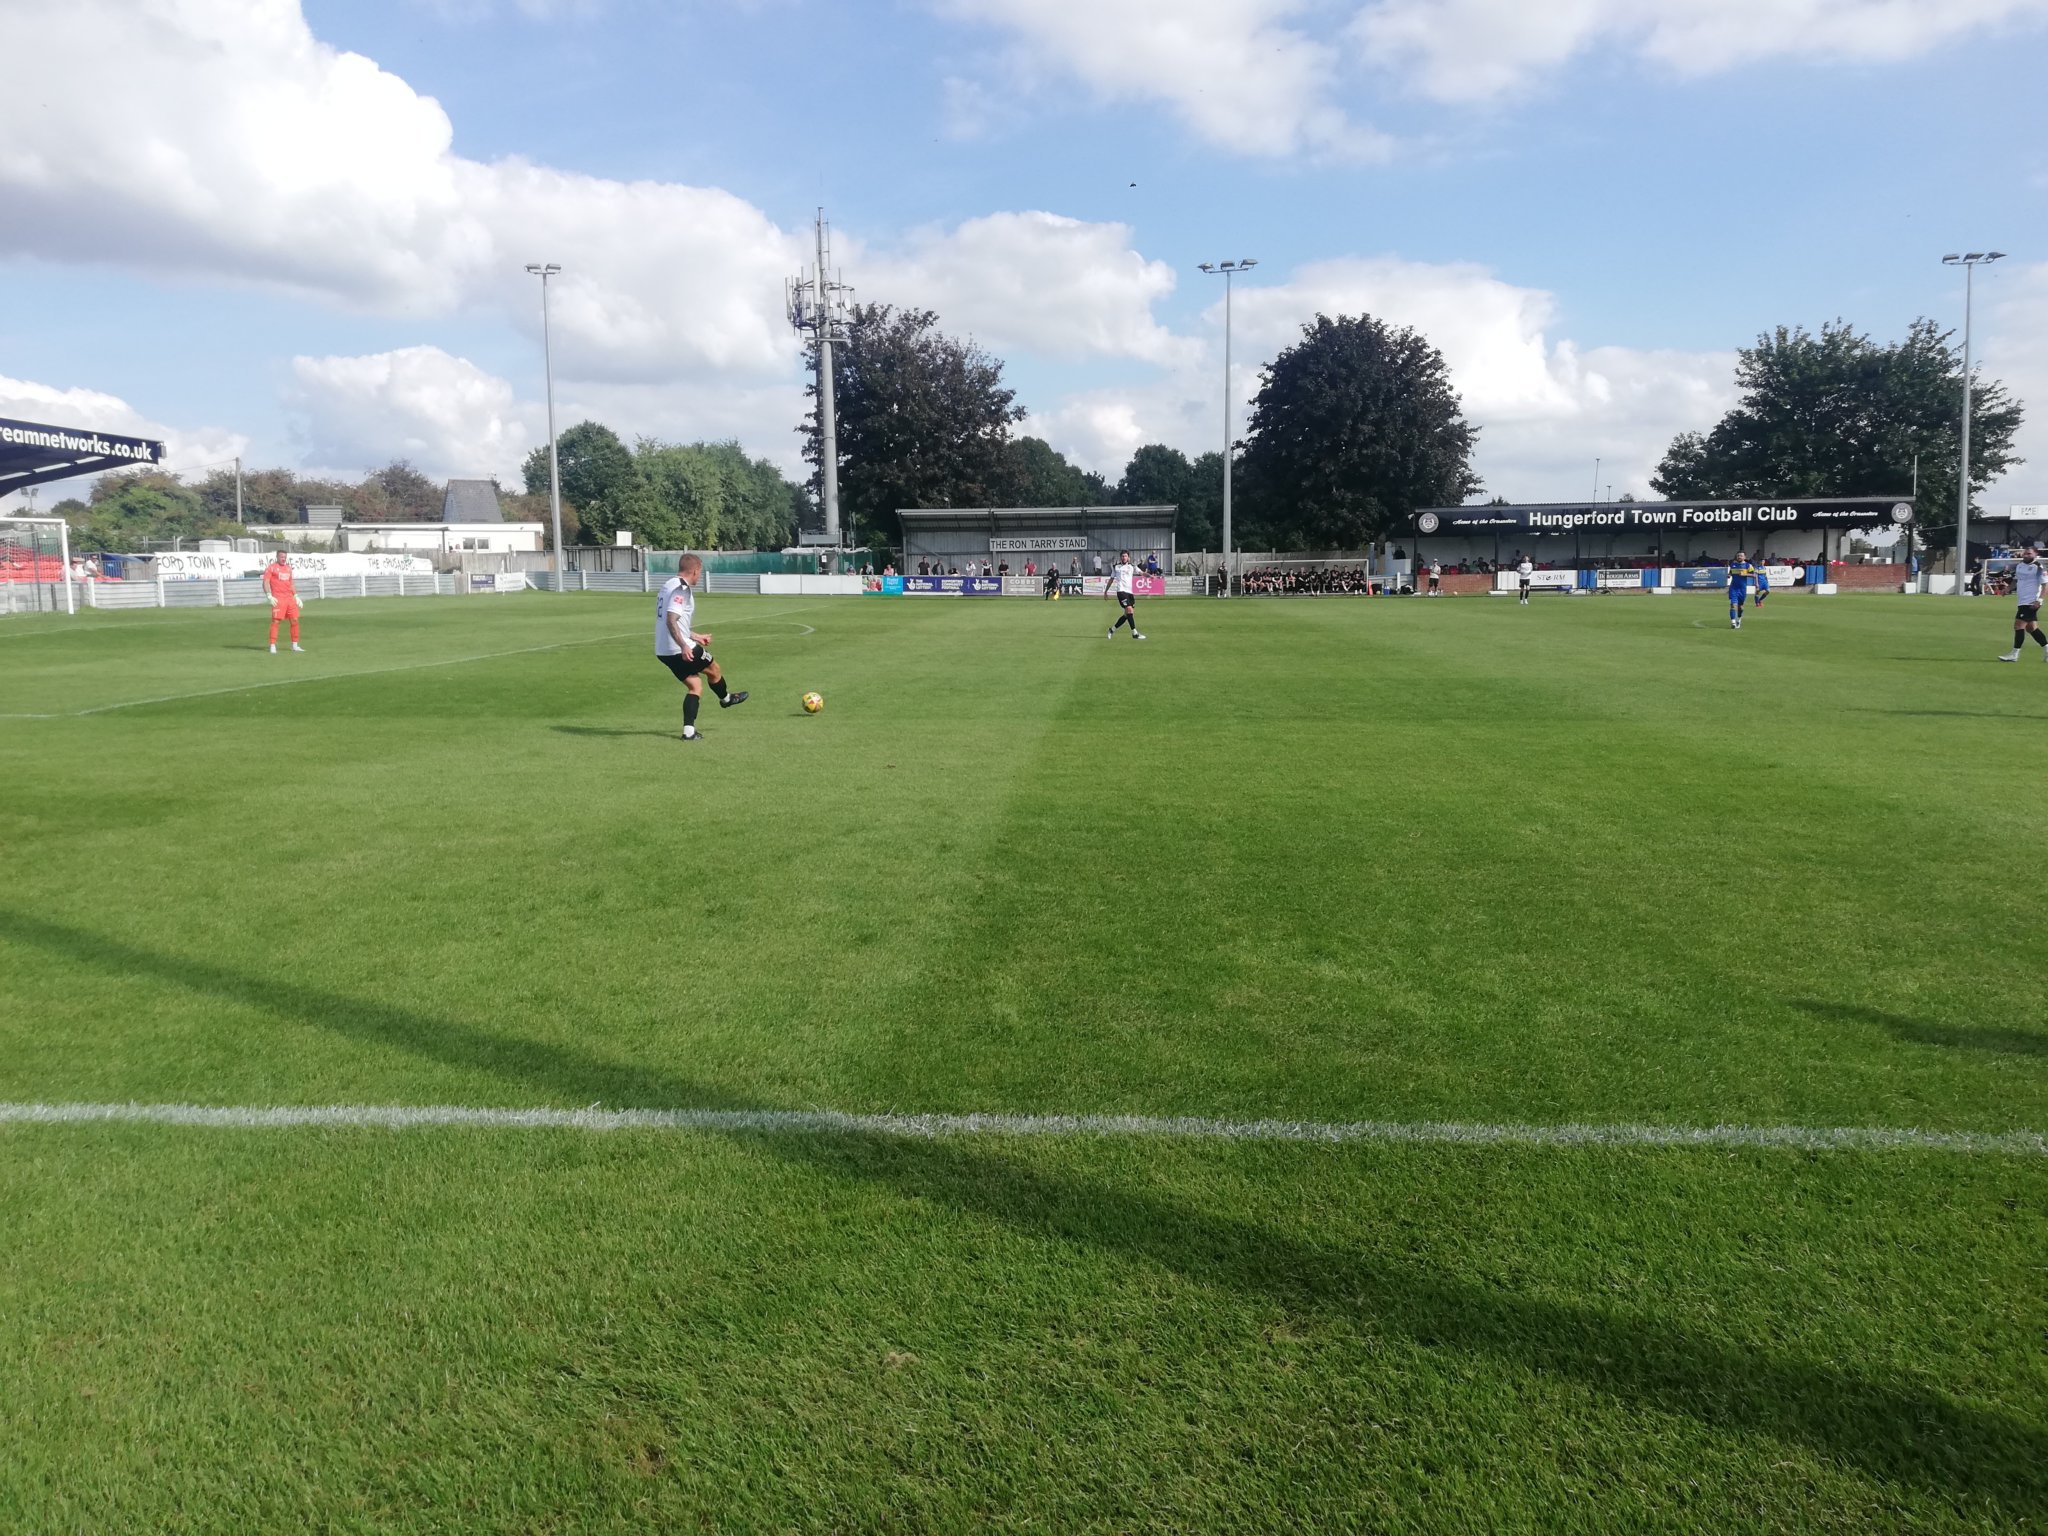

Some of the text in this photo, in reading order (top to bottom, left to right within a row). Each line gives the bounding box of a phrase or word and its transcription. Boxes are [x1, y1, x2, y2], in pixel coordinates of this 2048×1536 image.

[1529, 506, 1798, 528] Hungerford Town Football Club
[991, 539, 1087, 549] THE RON TARRY STAND
[187, 556, 216, 570] TOWN
[367, 557, 380, 569] THE
